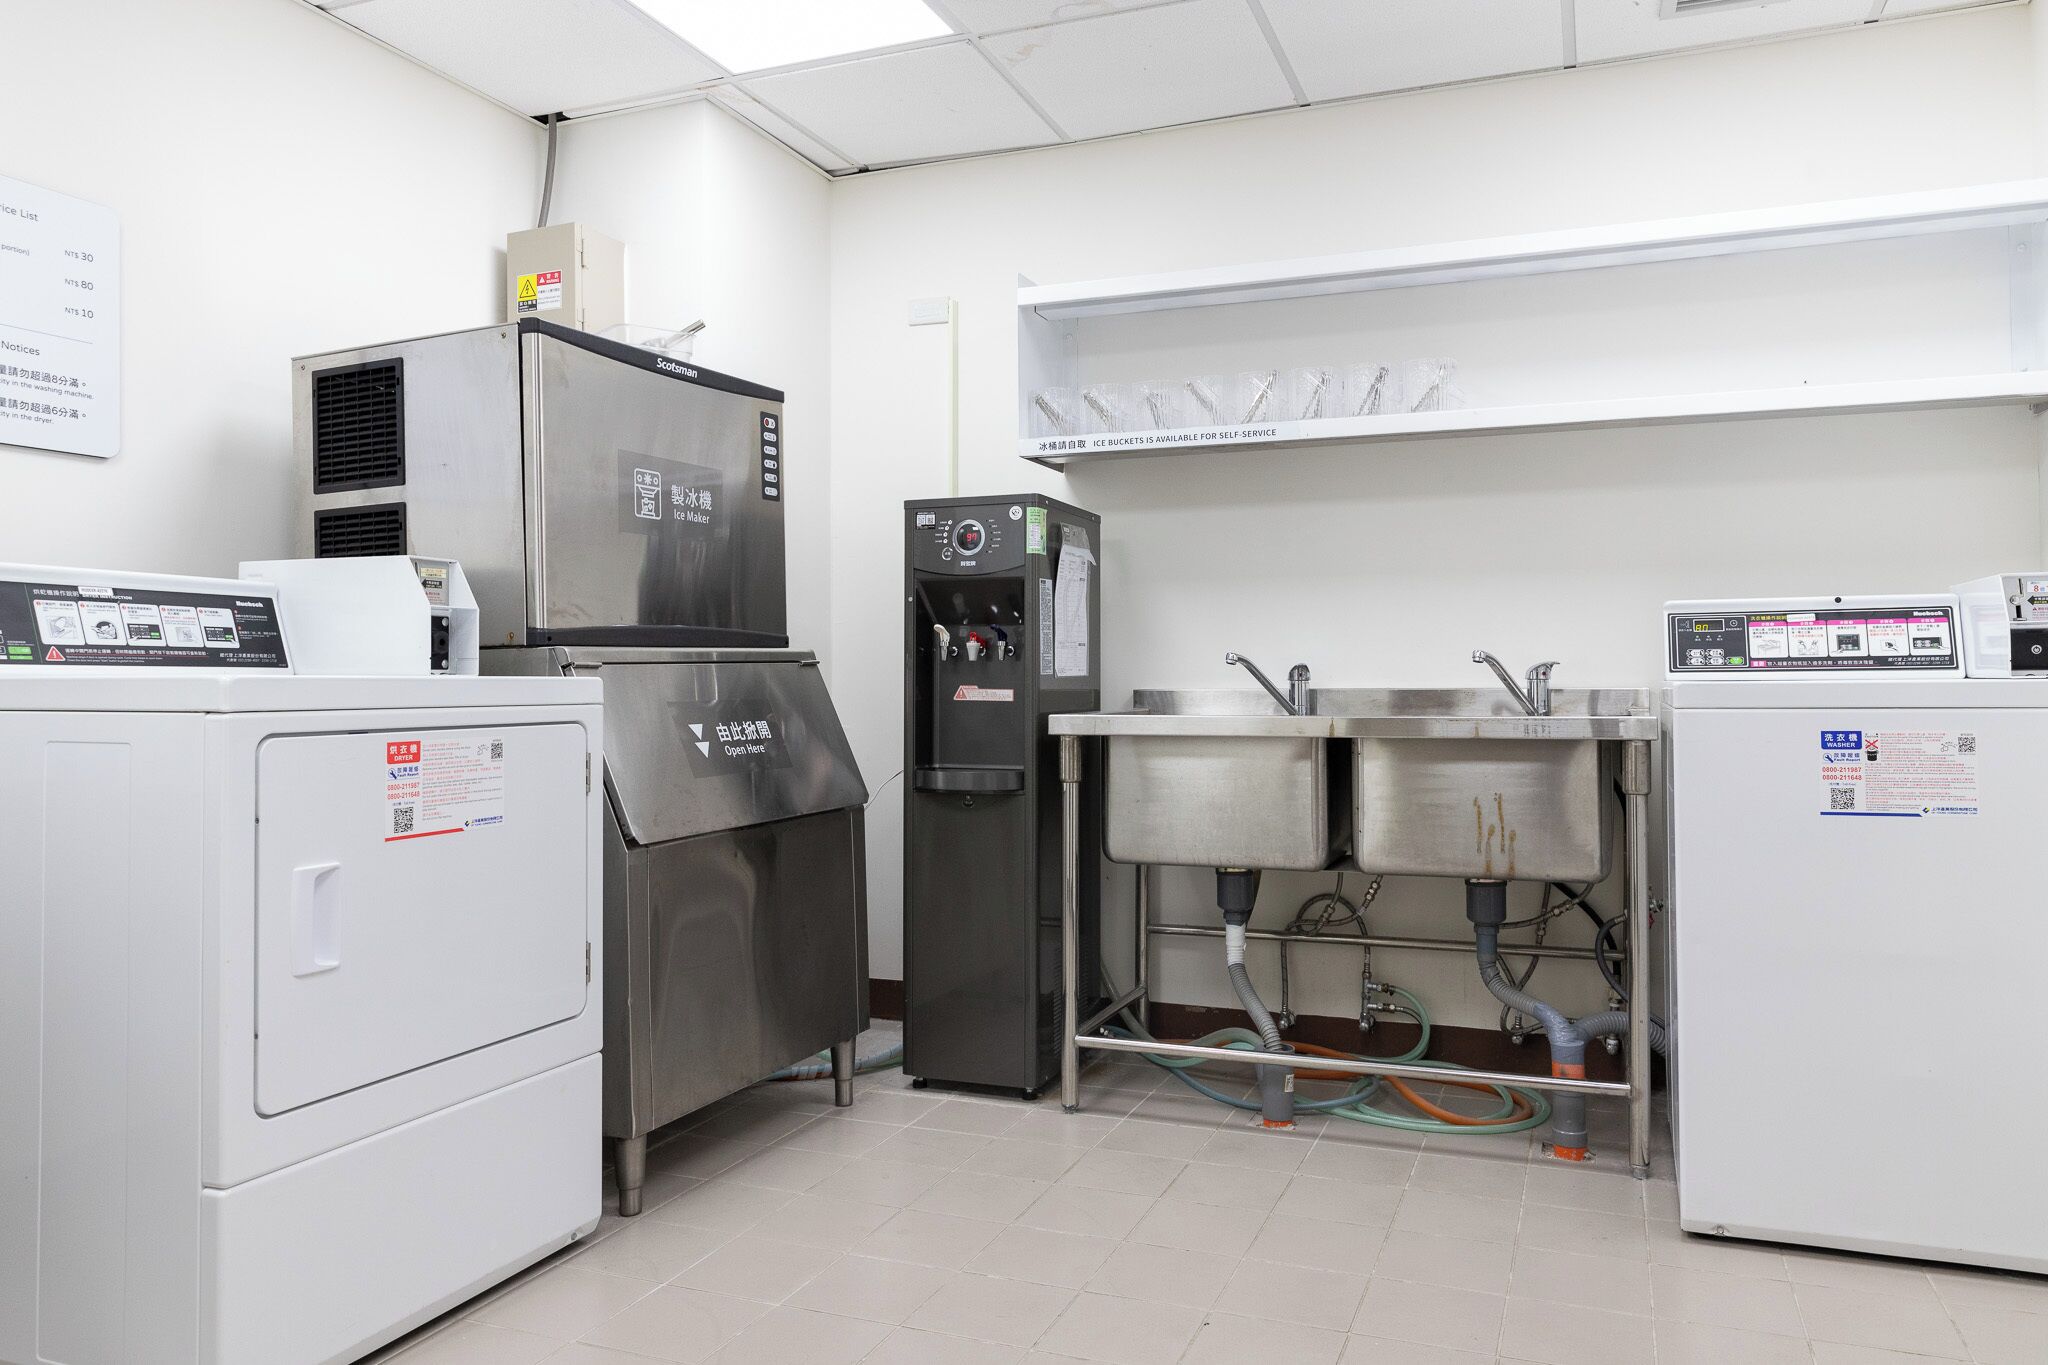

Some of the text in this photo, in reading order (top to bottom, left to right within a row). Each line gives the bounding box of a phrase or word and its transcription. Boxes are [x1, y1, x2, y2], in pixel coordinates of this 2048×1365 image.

[20, 208, 39, 222] List
[64, 249, 94, 263] NT$ 30
[64, 278, 94, 292] NT$ 80
[64, 306, 94, 320] NT$ 10
[1, 340, 40, 356] Notices
[656, 357, 698, 378] Scotsman
[20, 381, 33, 389] the
[34, 384, 63, 395] washing
[20, 413, 33, 421] the
[1039, 428, 1277, 451] 冰桶請自取 ICE BUCKETS IS AVAILABLE FOR SELF-SERVICE
[671, 484, 713, 511] 製冰機
[673, 509, 710, 524] Ice Maker
[715, 720, 772, 742] 由此掀開
[1824, 733, 1858, 742] 洗衣機
[389, 744, 418, 754] 烘衣機
[724, 743, 765, 758] Open Here
